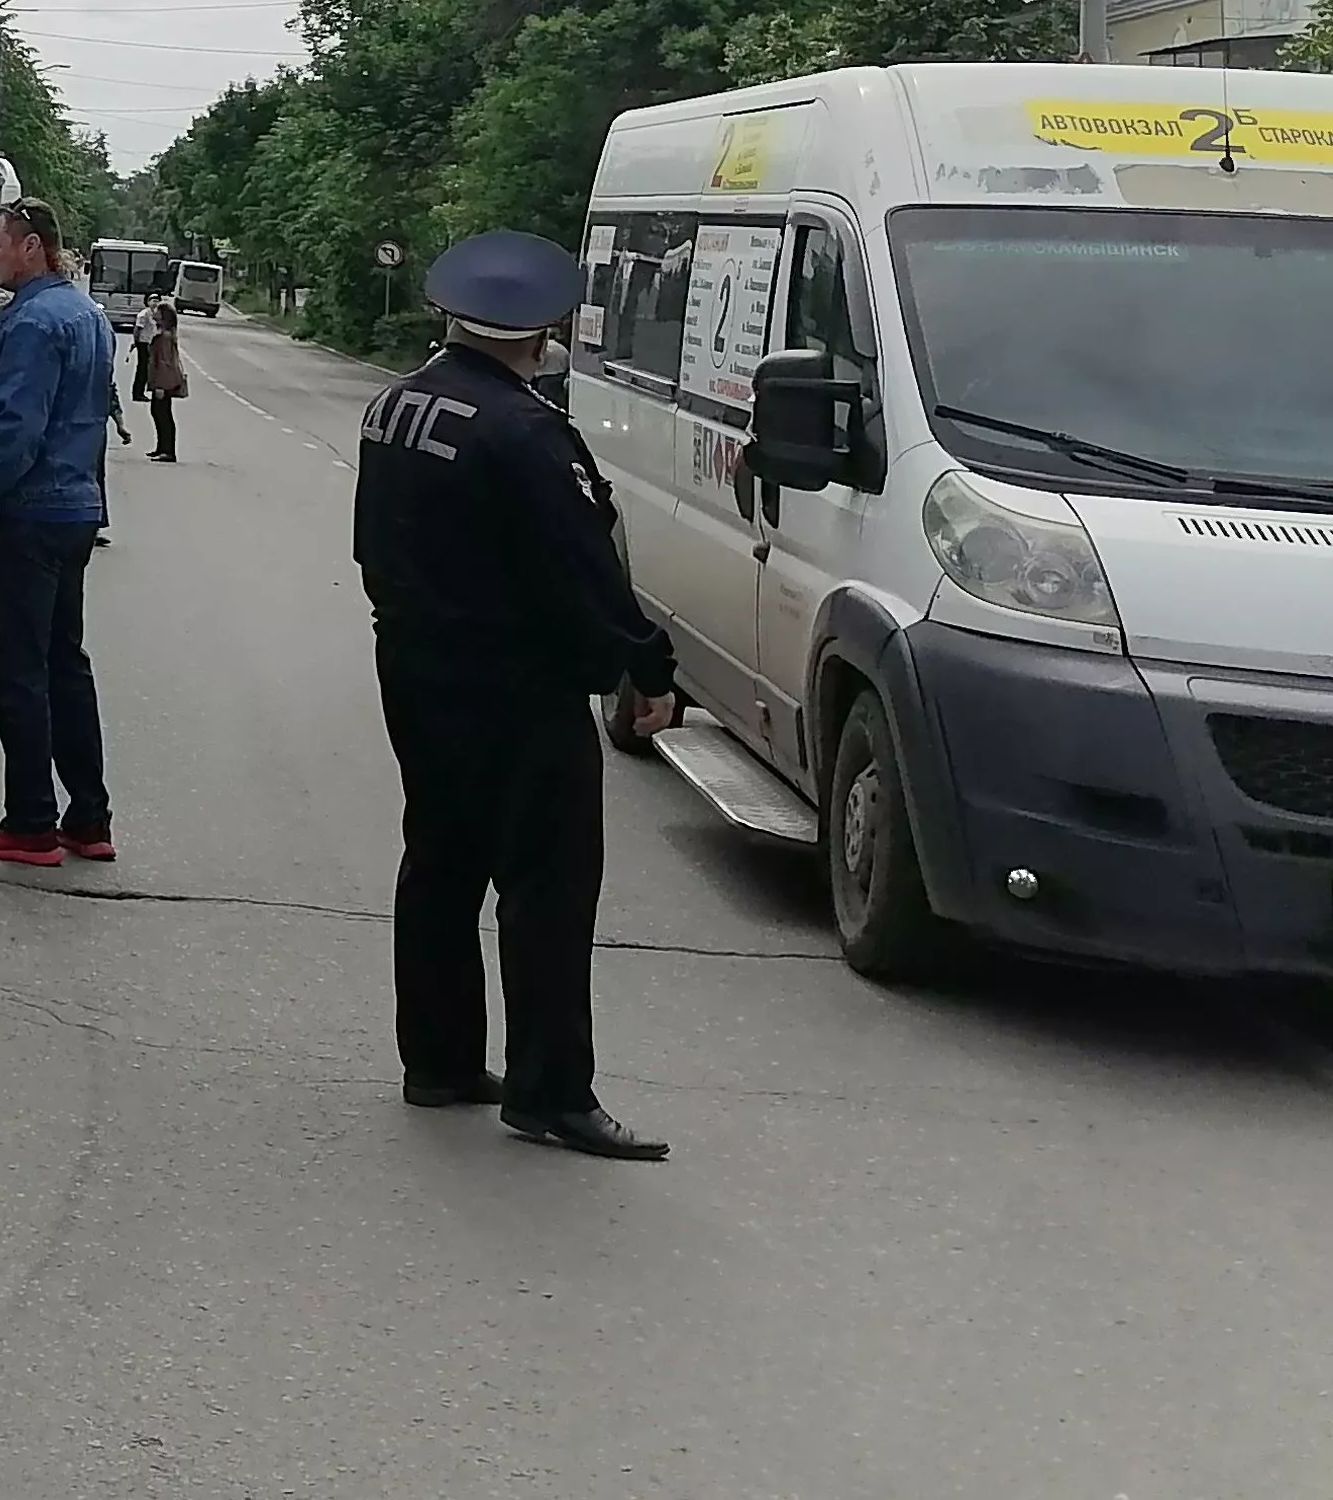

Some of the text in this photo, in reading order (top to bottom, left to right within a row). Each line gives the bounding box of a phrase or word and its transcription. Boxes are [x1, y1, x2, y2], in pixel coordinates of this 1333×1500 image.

[1040, 113, 1183, 138] АВТОВОКЗАЛ
[714, 274, 731, 354] 2
[362, 387, 477, 461] ДПС
